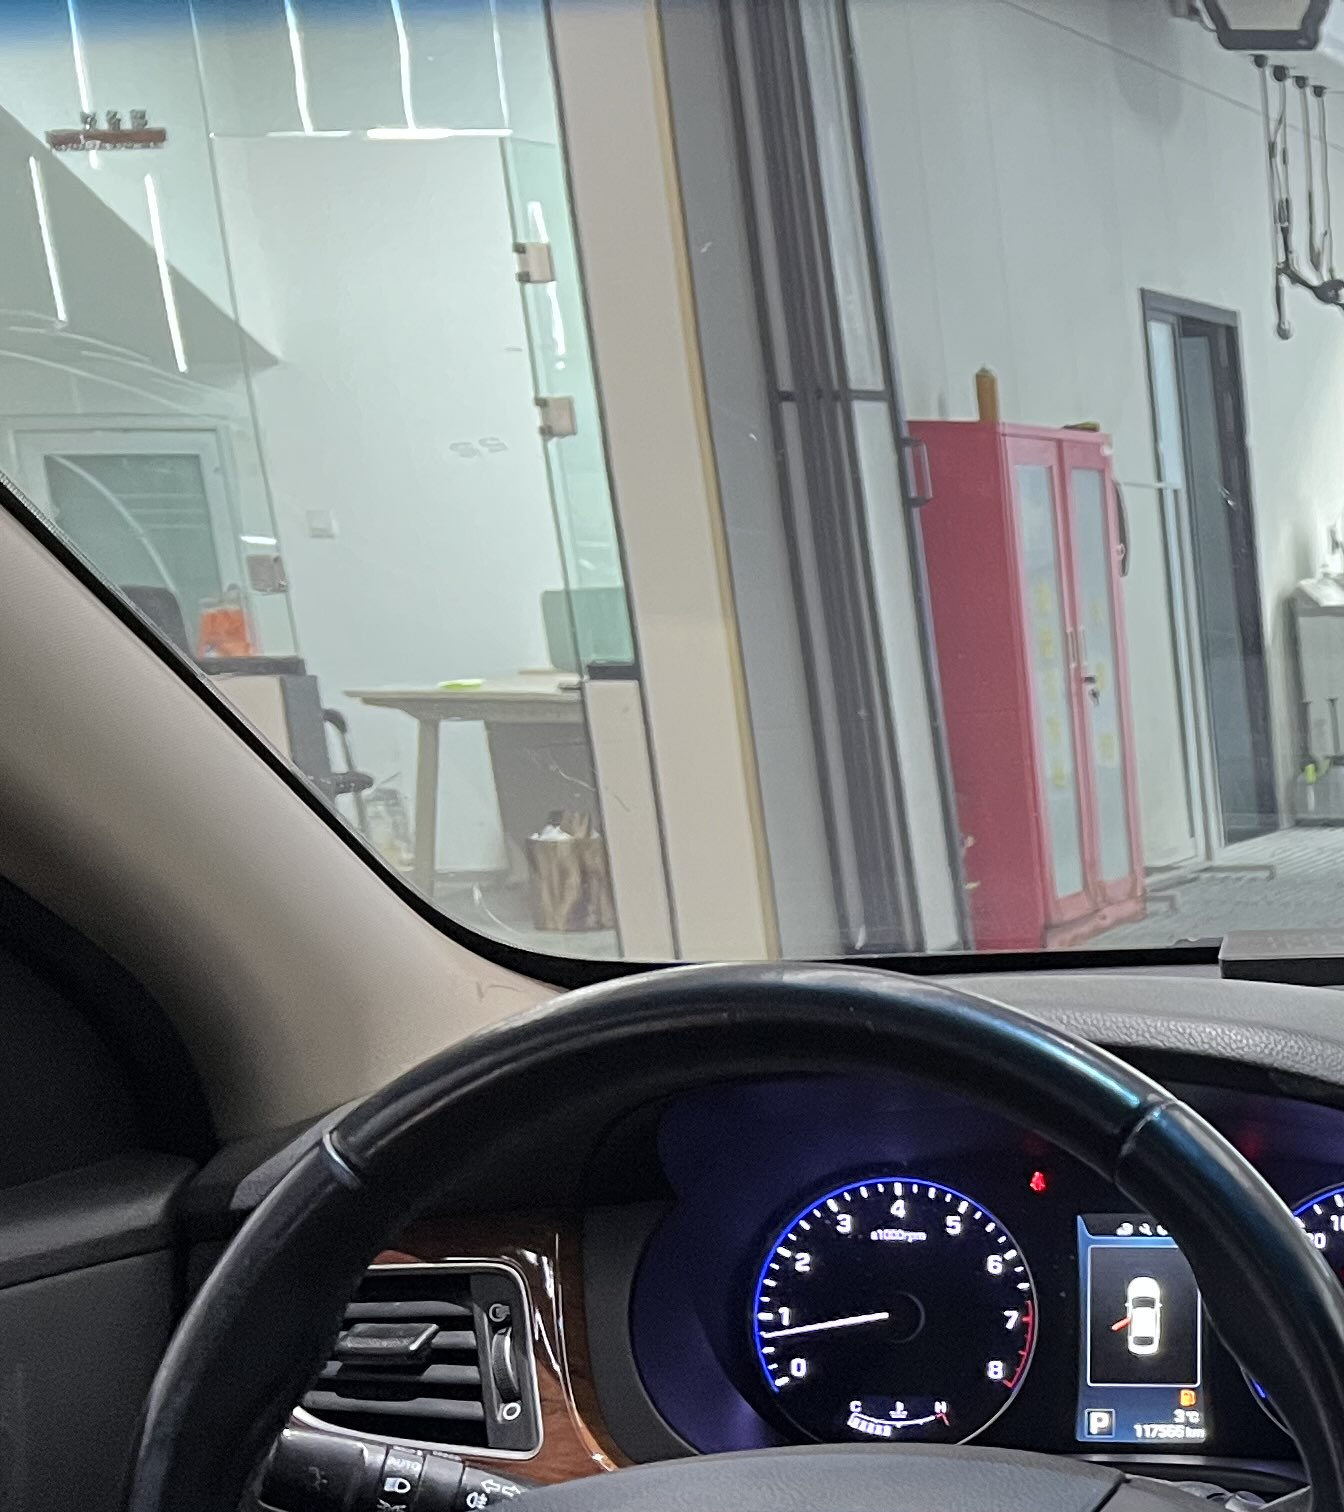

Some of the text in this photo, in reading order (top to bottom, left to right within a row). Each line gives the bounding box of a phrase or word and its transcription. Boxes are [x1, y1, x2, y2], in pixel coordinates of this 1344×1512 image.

[890, 1199, 906, 1218] 4
[835, 1213, 852, 1234] 3
[945, 1215, 961, 1235] 5
[794, 1252, 811, 1272] 2
[986, 1254, 1003, 1275] 6
[778, 1306, 791, 1326] 1
[1003, 1309, 1019, 1330] 7
[790, 1357, 807, 1377] 0
[987, 1360, 1004, 1379] 8
[849, 1400, 862, 1413] C
[1089, 1411, 1111, 1435] P
[386, 1455, 422, 1473] AUTO
